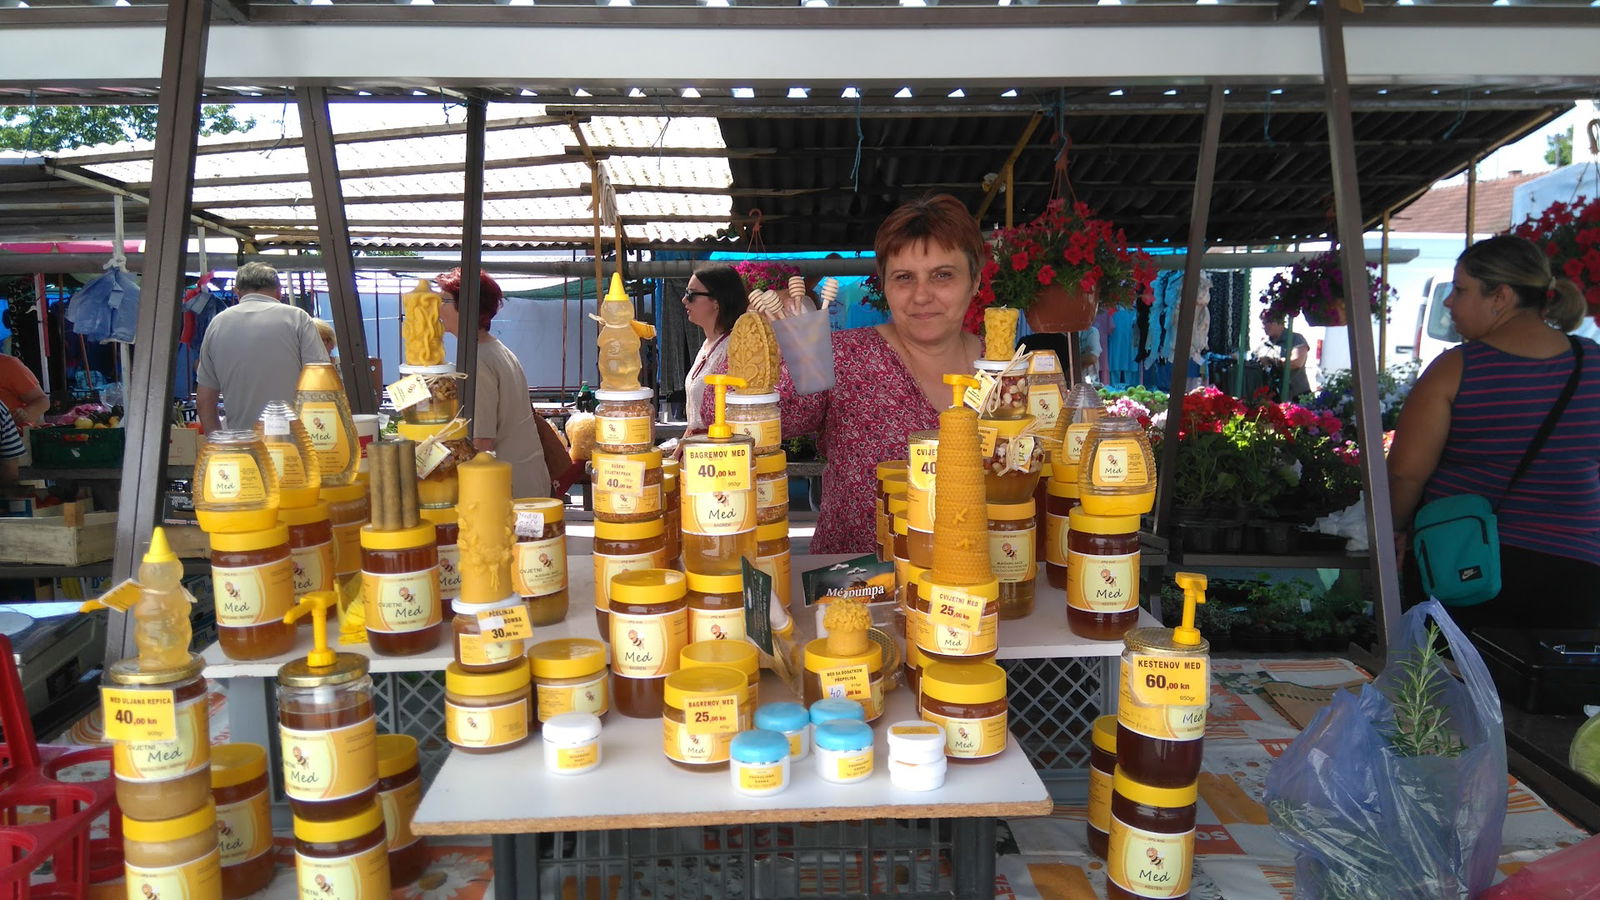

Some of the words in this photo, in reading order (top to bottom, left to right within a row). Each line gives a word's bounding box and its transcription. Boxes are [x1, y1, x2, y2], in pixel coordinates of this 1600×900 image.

[690, 450, 728, 459] BAGREMOV
[731, 449, 746, 457] MED
[698, 464, 727, 478] 40,00
[216, 482, 236, 490] Med
[708, 507, 737, 520] Med
[1096, 588, 1124, 599] Med
[224, 602, 250, 613] Med
[395, 606, 424, 618] Med
[944, 639, 963, 647] Med
[624, 651, 653, 663] Med
[1138, 660, 1180, 670] KESTENOV
[1184, 662, 1201, 670] MED
[1145, 674, 1179, 691] 60,00
[1180, 682, 1190, 690] kn
[122, 697, 146, 705] ULJANA
[147, 697, 172, 705] REPICA
[688, 700, 720, 708] BAGREMOV
[115, 709, 146, 725] 40,00
[1182, 709, 1204, 724] Med
[955, 741, 975, 749] Med
[147, 747, 183, 763] Med
[290, 770, 319, 784] Med
[1139, 869, 1171, 882] Med
